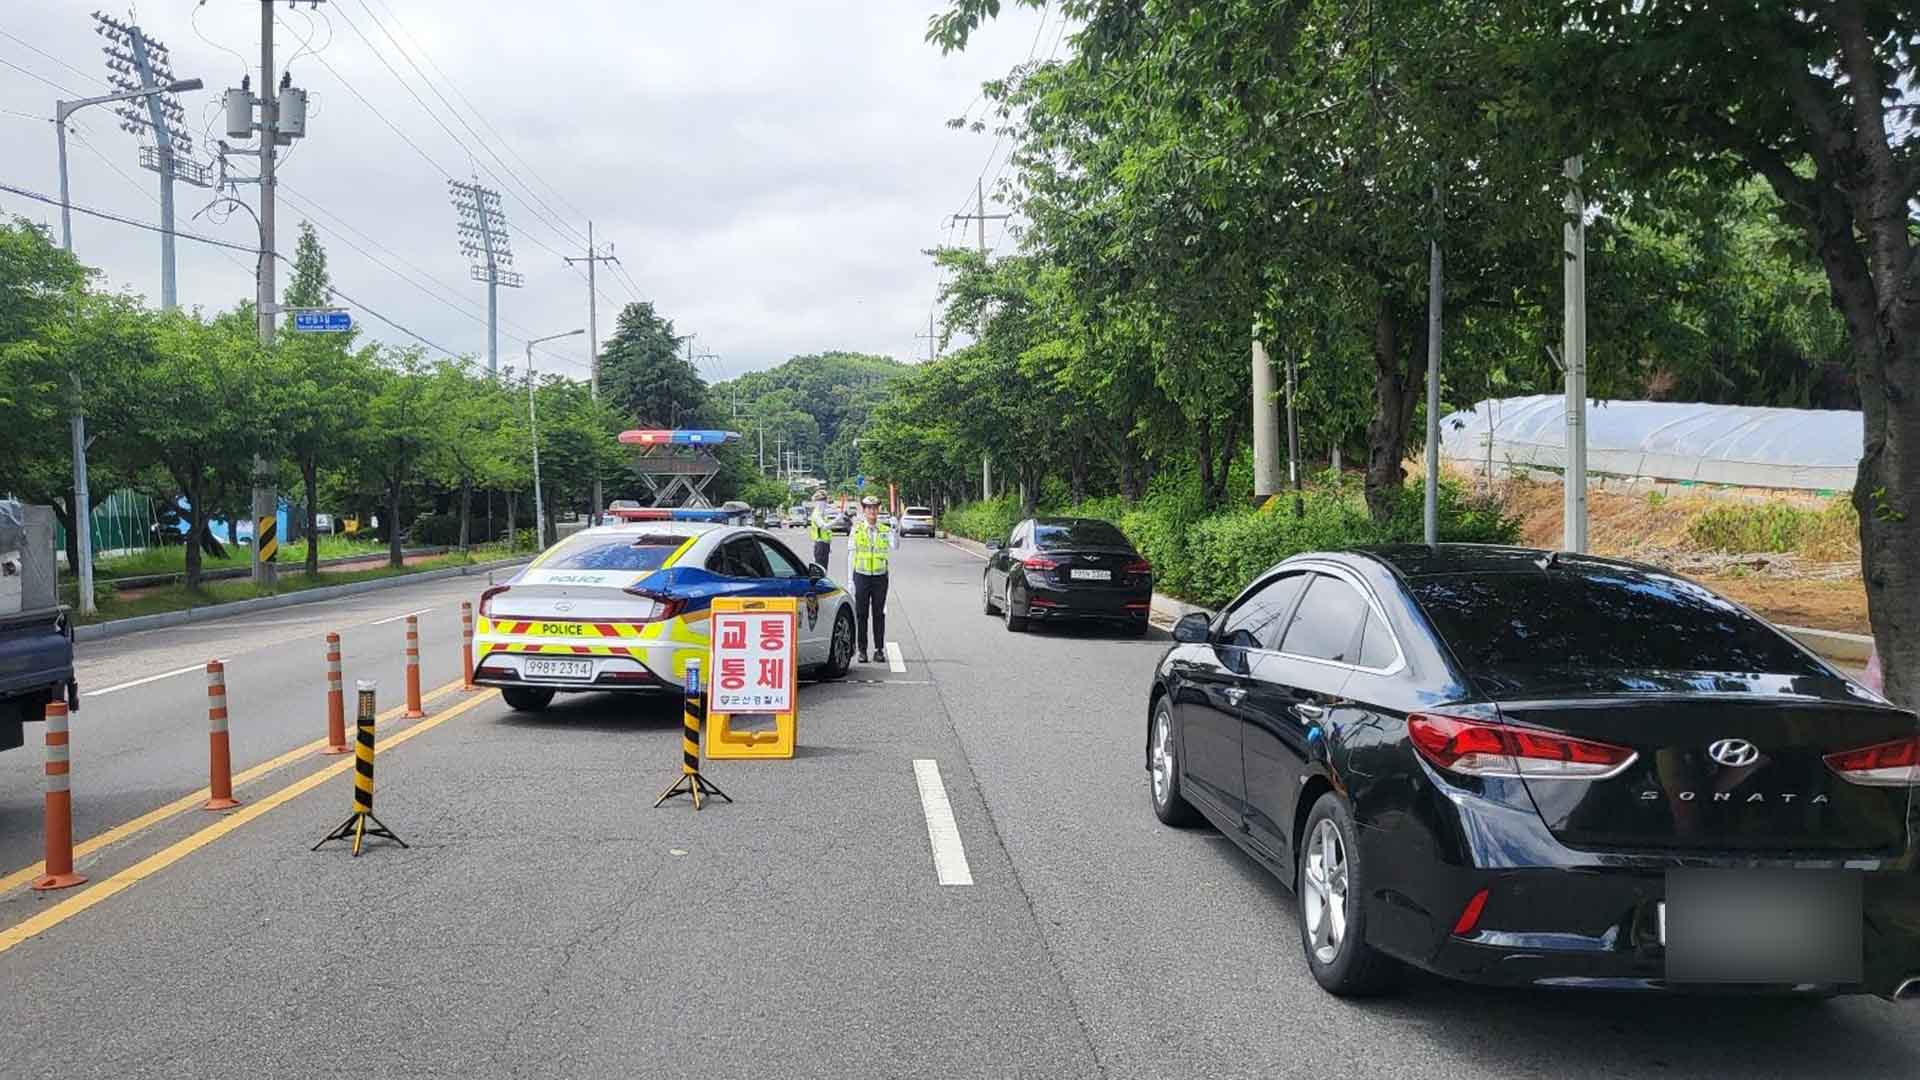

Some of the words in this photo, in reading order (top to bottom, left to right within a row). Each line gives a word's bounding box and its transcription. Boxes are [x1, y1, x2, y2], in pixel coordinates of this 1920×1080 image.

[548, 575, 606, 584] POLICE
[542, 624, 583, 635] POLICE
[720, 620, 785, 651] 교통
[559, 662, 587, 674] 2314
[720, 658, 784, 690] 통제
[1640, 791, 1830, 804] SONATA
